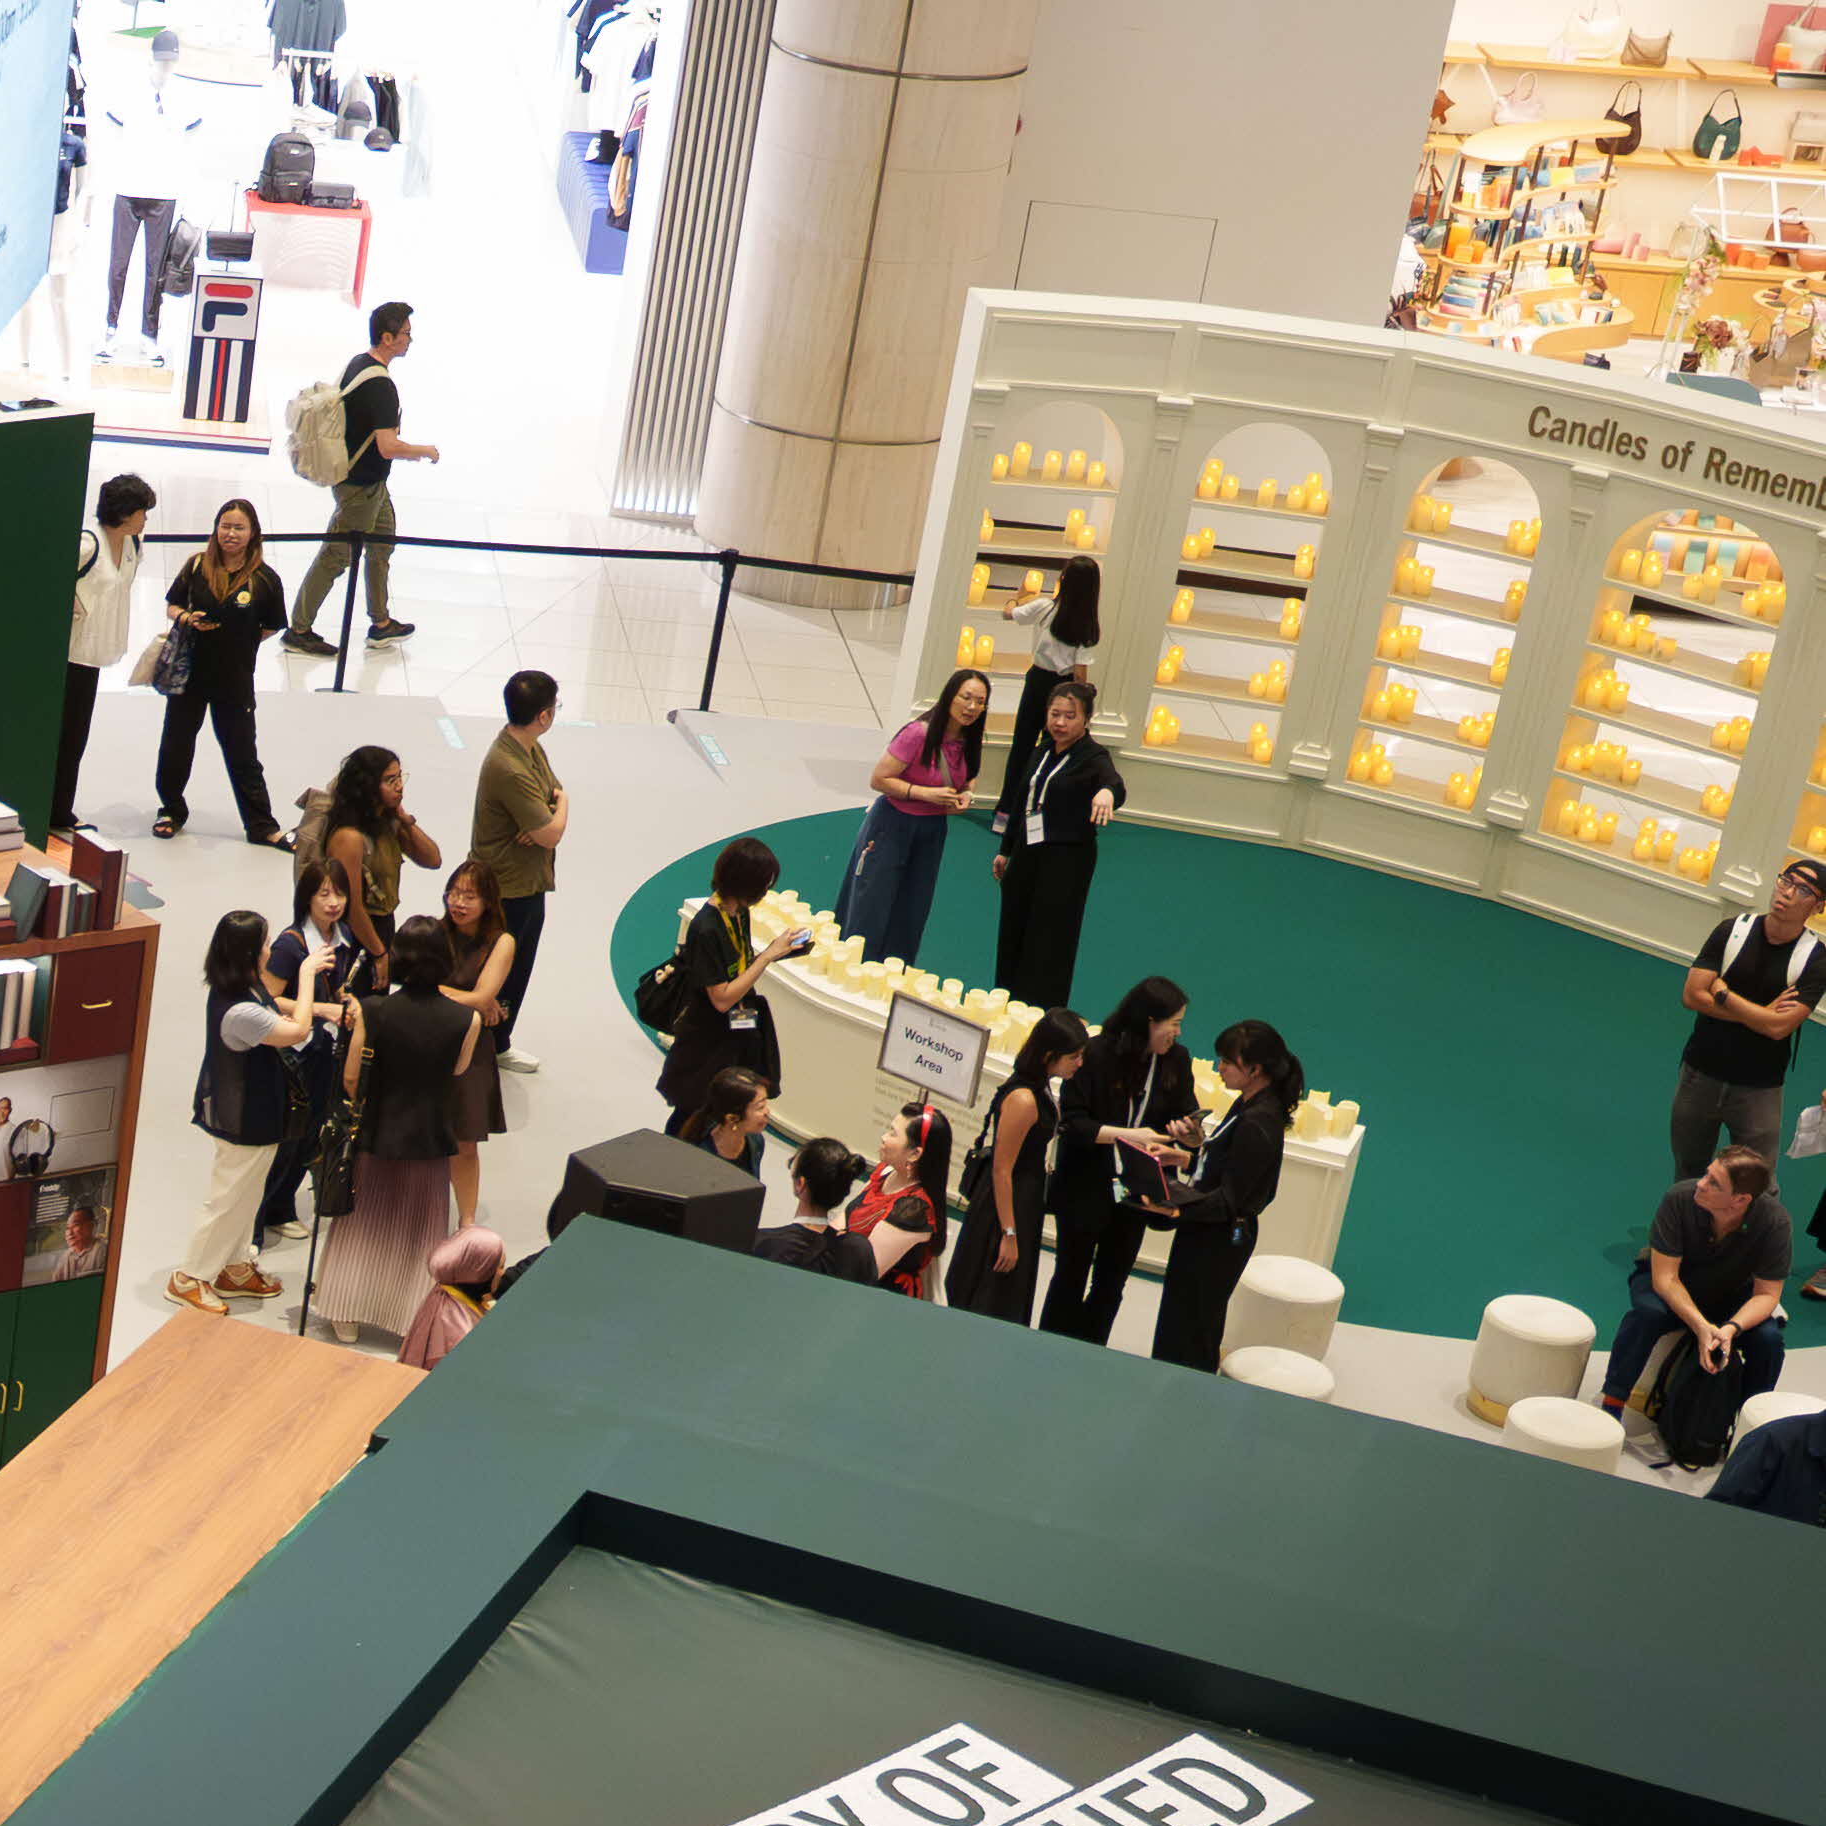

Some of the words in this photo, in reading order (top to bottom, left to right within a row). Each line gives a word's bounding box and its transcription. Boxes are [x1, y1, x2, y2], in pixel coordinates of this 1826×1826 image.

[1528, 406, 1647, 460] Candles
[1661, 440, 1695, 472] of
[905, 1027, 963, 1062] Workshop
[915, 1054, 943, 1074] Area
